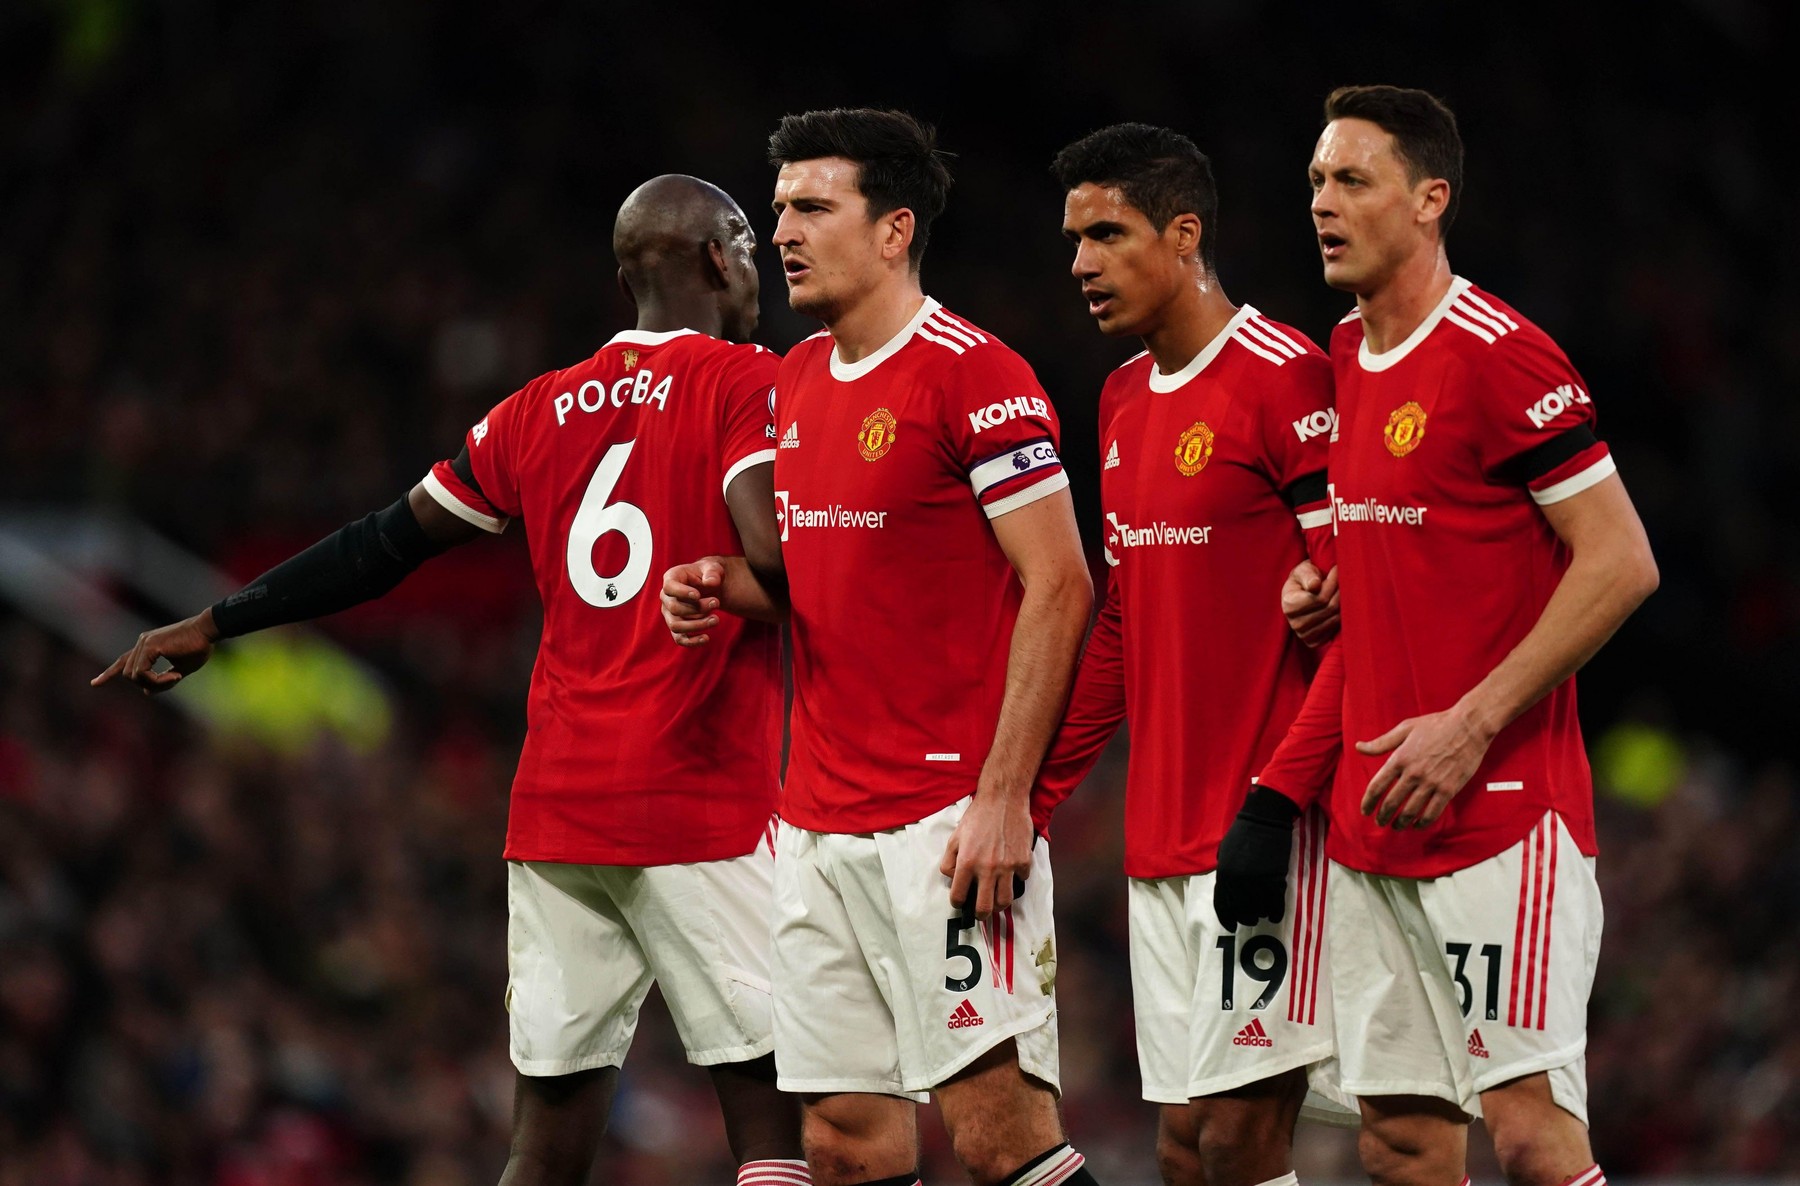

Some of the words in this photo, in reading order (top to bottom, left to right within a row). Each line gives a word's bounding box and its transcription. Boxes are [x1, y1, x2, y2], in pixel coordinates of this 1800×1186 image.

[554, 369, 673, 426] POGBA
[864, 411, 894, 428] MANCHESTER
[968, 396, 1051, 434] KOHLER
[862, 448, 884, 458] UNITED
[566, 436, 653, 608] 6
[789, 503, 888, 529] TeamViewer
[1334, 497, 1427, 525] TeamViewer
[945, 917, 982, 992] 5
[1216, 934, 1288, 1010] 19
[1446, 942, 1502, 1020] 31
[947, 1016, 984, 1030] adidas
[1233, 1035, 1273, 1048] adidas
